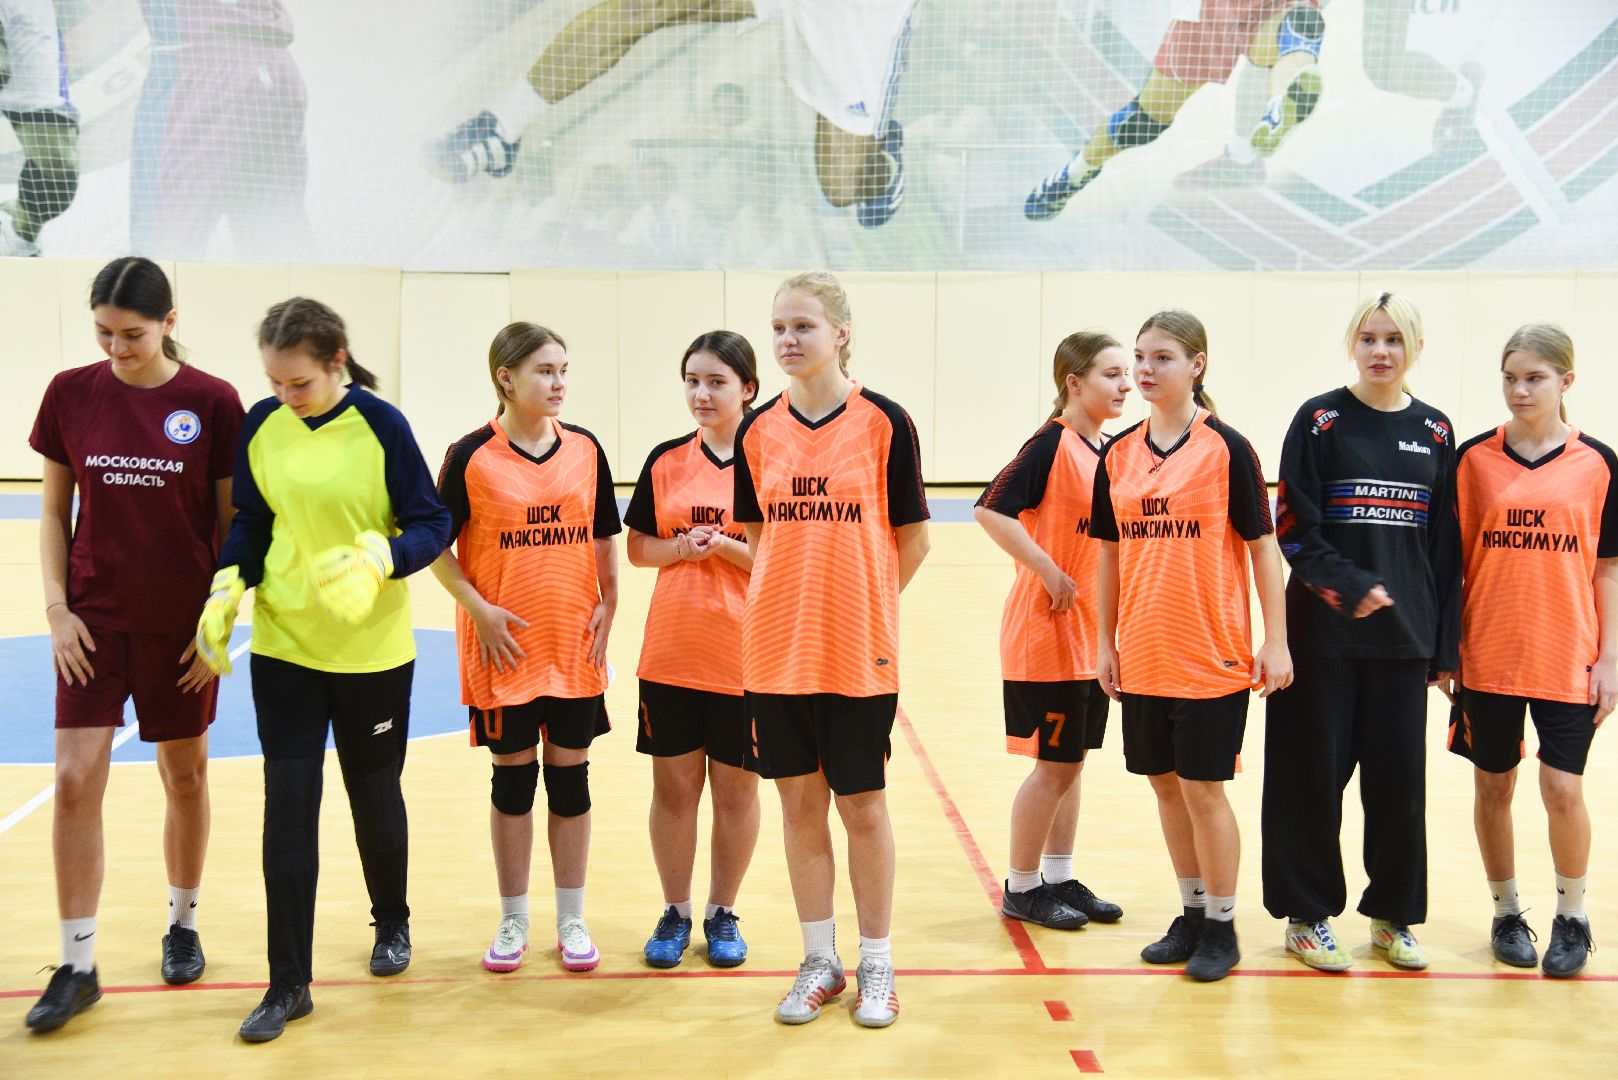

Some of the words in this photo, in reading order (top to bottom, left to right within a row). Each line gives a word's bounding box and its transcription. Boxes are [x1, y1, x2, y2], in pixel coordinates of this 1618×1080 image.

[85, 455, 184, 473] МОСКОВСКАЯ
[102, 473, 166, 487] ОБЛАСТЬ
[792, 476, 828, 497] ШСК
[1355, 485, 1418, 501] MARTINI
[526, 504, 562, 525] ШСК
[691, 506, 726, 526] ШСК
[768, 502, 861, 524] МАКСИМУМ
[1142, 498, 1169, 517] ШСК
[1352, 506, 1415, 521] RACING
[1507, 509, 1546, 528] ШСК
[500, 526, 588, 549] МАКСИМУМ
[1121, 520, 1201, 539] МАКСИМУМ
[1482, 530, 1579, 553] МАКСИМУМ
[1045, 712, 1066, 747] 7
